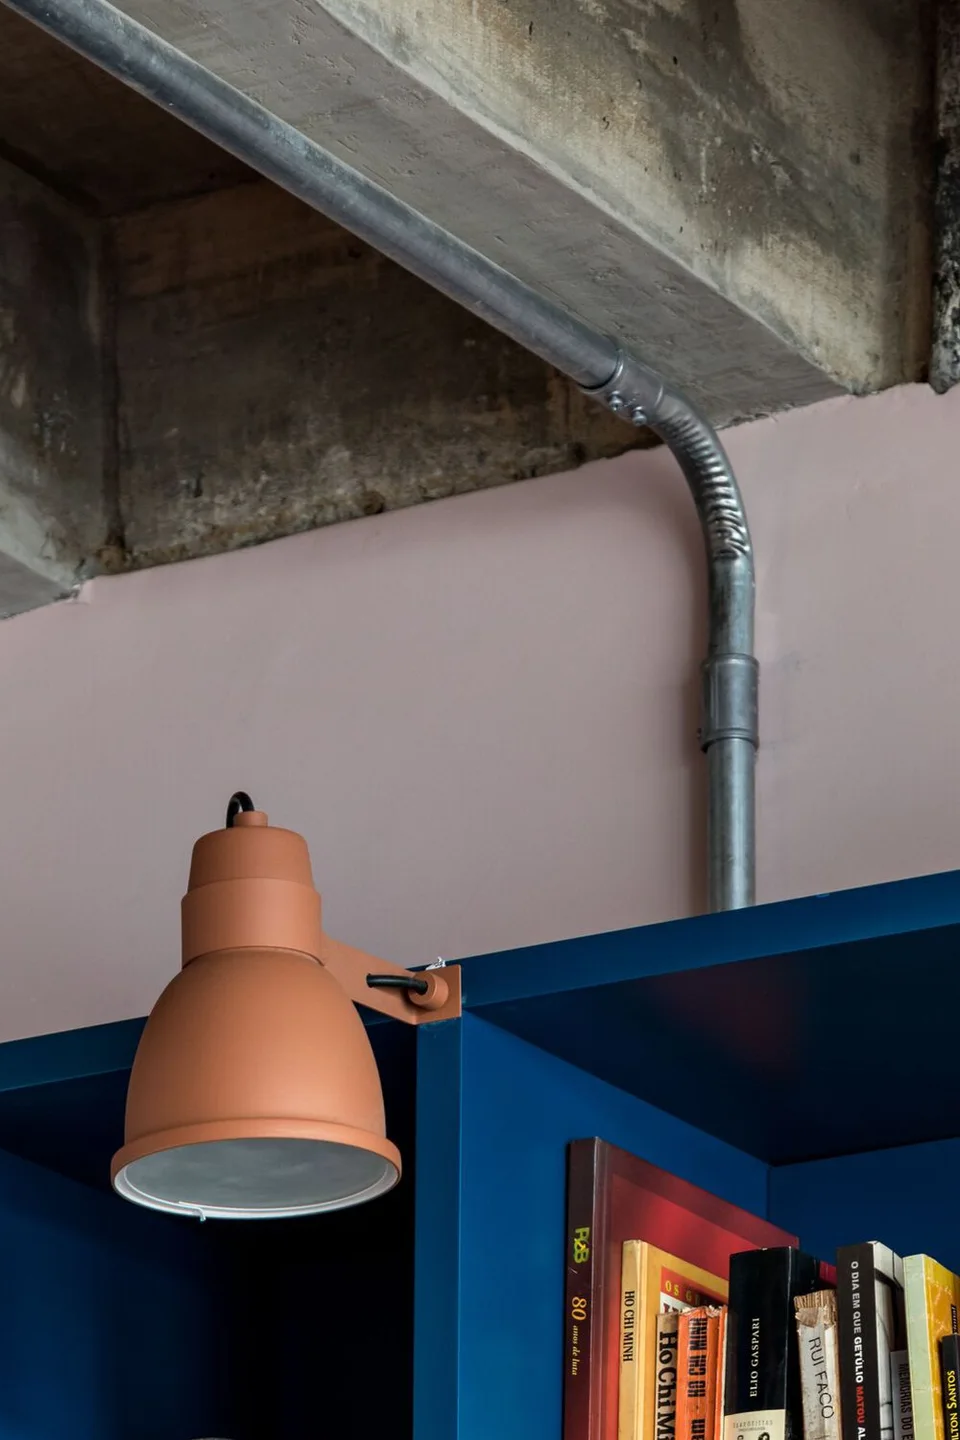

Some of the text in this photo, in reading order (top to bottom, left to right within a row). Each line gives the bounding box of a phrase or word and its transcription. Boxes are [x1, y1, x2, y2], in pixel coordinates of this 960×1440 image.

[850, 1261, 859, 1269] O
[851, 1271, 860, 1290] DIA
[571, 1296, 587, 1321] 80
[851, 1292, 861, 1309] EM
[623, 1290, 636, 1362] HO CHI MINH
[689, 1317, 708, 1351] MINH
[852, 1311, 862, 1334] QUE
[571, 1325, 581, 1376] anos de luta
[749, 1317, 761, 1398] ELIO GASPARI
[808, 1337, 826, 1366] RUI
[853, 1336, 864, 1384] GETÚLIO
[688, 1355, 707, 1376] CHI
[687, 1380, 706, 1398] HO
[855, 1386, 866, 1423] MATOU
[901, 1418, 914, 1430] DO
